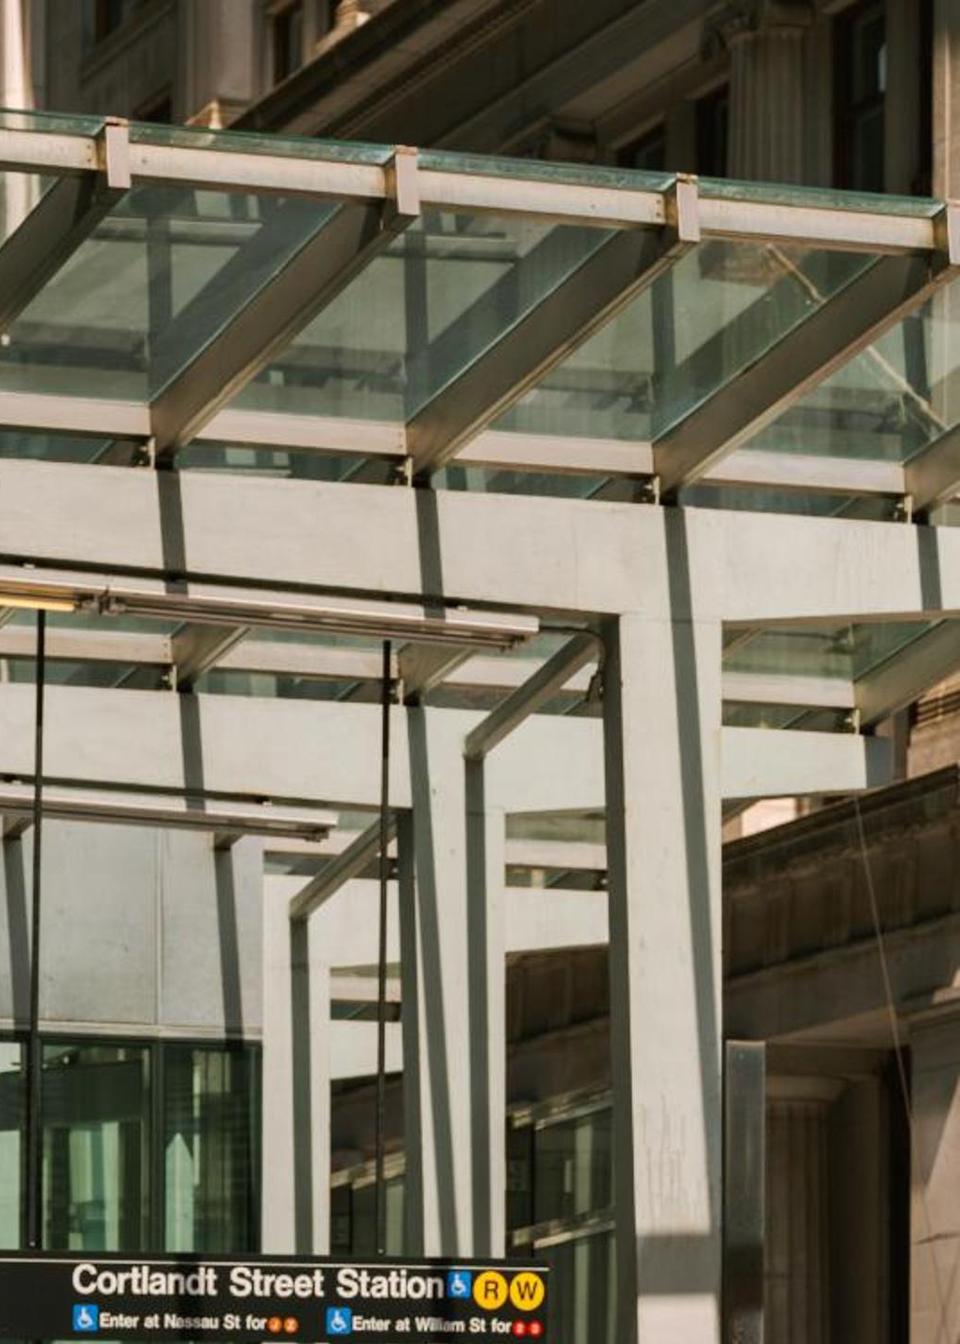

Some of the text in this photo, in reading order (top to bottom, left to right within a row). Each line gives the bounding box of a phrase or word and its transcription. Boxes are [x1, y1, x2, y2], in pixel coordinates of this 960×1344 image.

[72, 1263, 218, 1295] Cortlandt
[229, 1266, 324, 1297] Street
[336, 1268, 444, 1299] Station
[99, 1313, 139, 1329] Enter
[144, 1314, 159, 1329] at
[164, 1313, 219, 1330] Nassau
[223, 1313, 241, 1330] St
[246, 1313, 267, 1330] for
[352, 1315, 390, 1332] Enter
[395, 1316, 410, 1331] at
[469, 1317, 486, 1333] St
[491, 1317, 512, 1333] for
